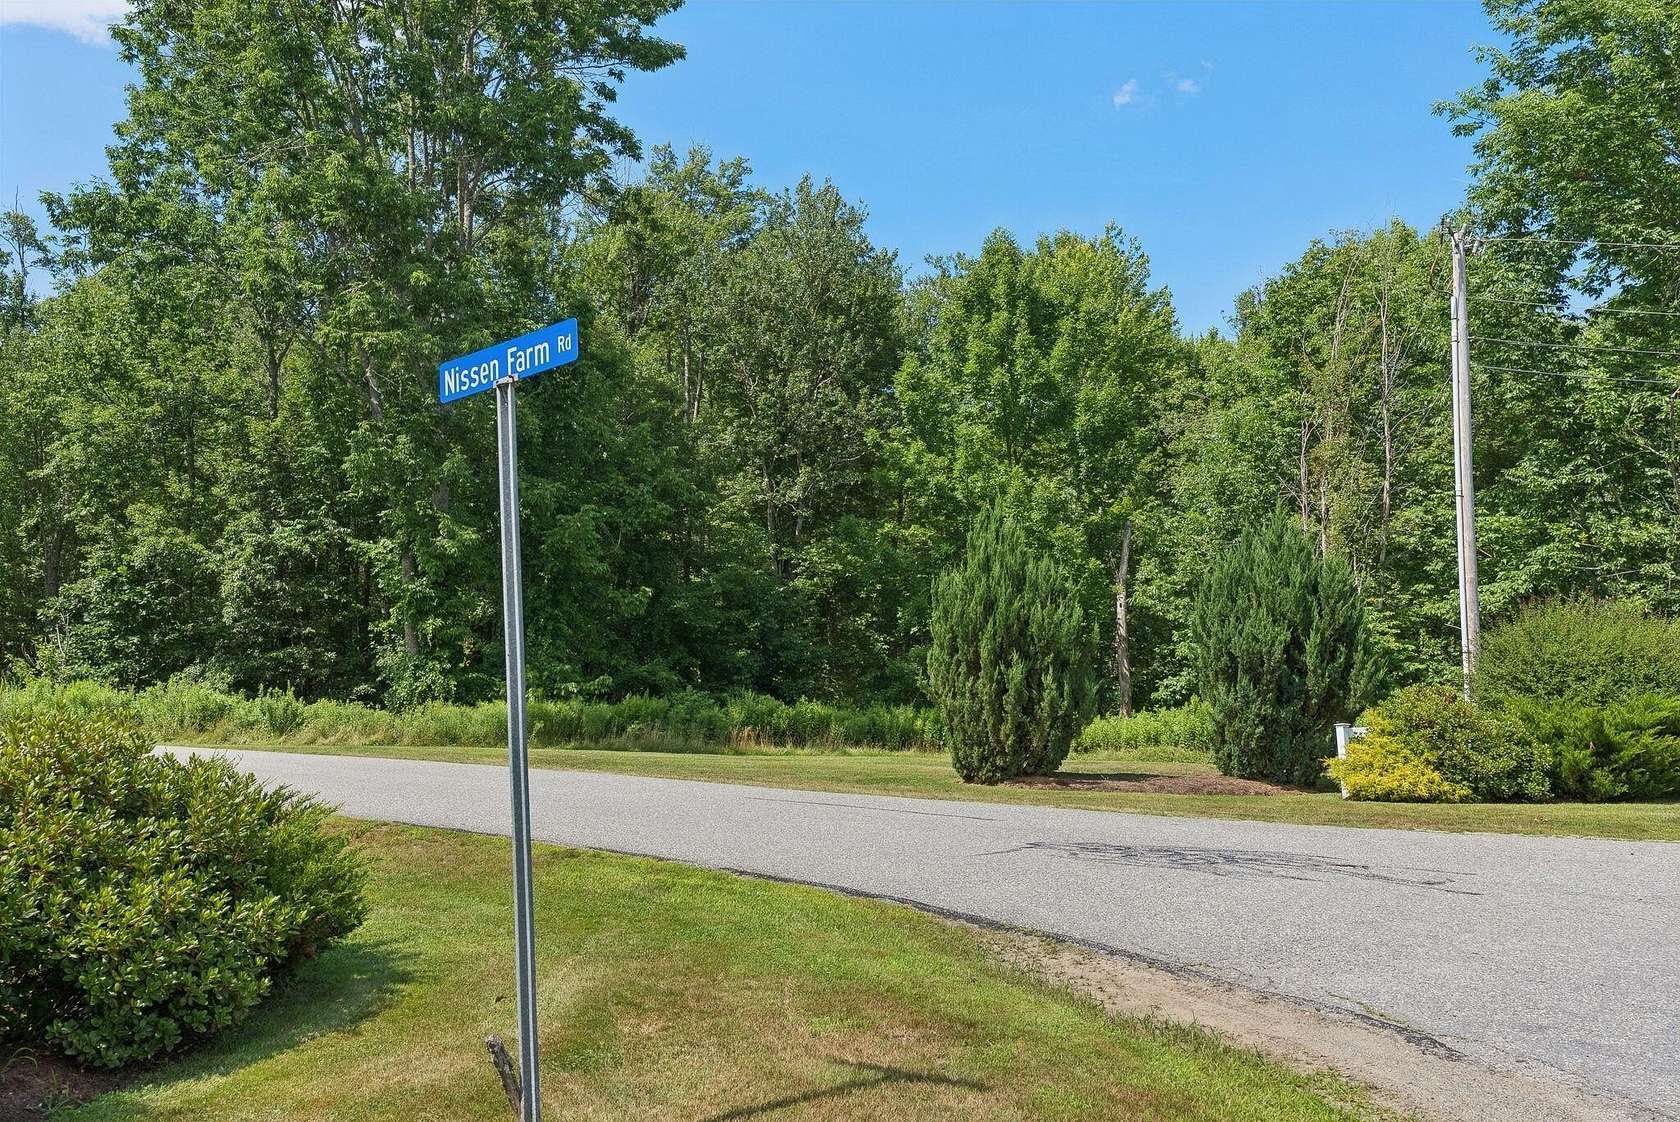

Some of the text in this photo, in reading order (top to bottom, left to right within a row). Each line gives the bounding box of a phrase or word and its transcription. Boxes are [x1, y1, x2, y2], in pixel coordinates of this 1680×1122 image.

[444, 333, 572, 396] Nissen Farm Rd
